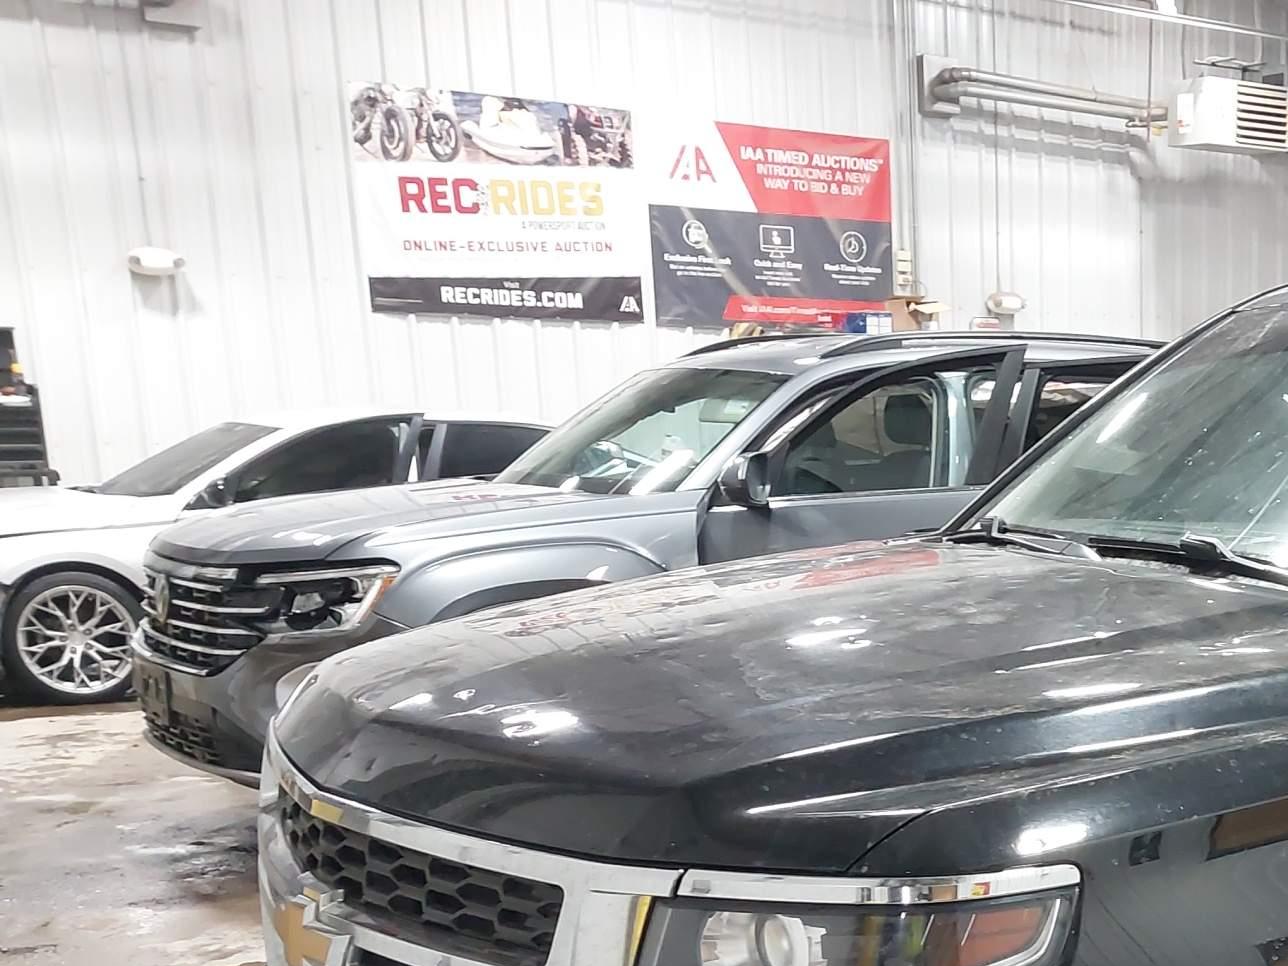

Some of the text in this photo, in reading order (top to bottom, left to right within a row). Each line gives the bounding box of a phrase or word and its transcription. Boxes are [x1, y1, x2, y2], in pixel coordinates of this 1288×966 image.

[740, 146, 764, 161] IAA
[764, 149, 809, 166] TIMED
[756, 163, 872, 184] INTRODUCING A NEW
[398, 176, 481, 214] REC
[489, 178, 605, 216] RIDES
[764, 177, 864, 196] WAY TO BID & BUY
[403, 240, 612, 252] ONLINE-EXCLUSIVE AUCTION
[440, 286, 584, 309] RECRIDES.COM
